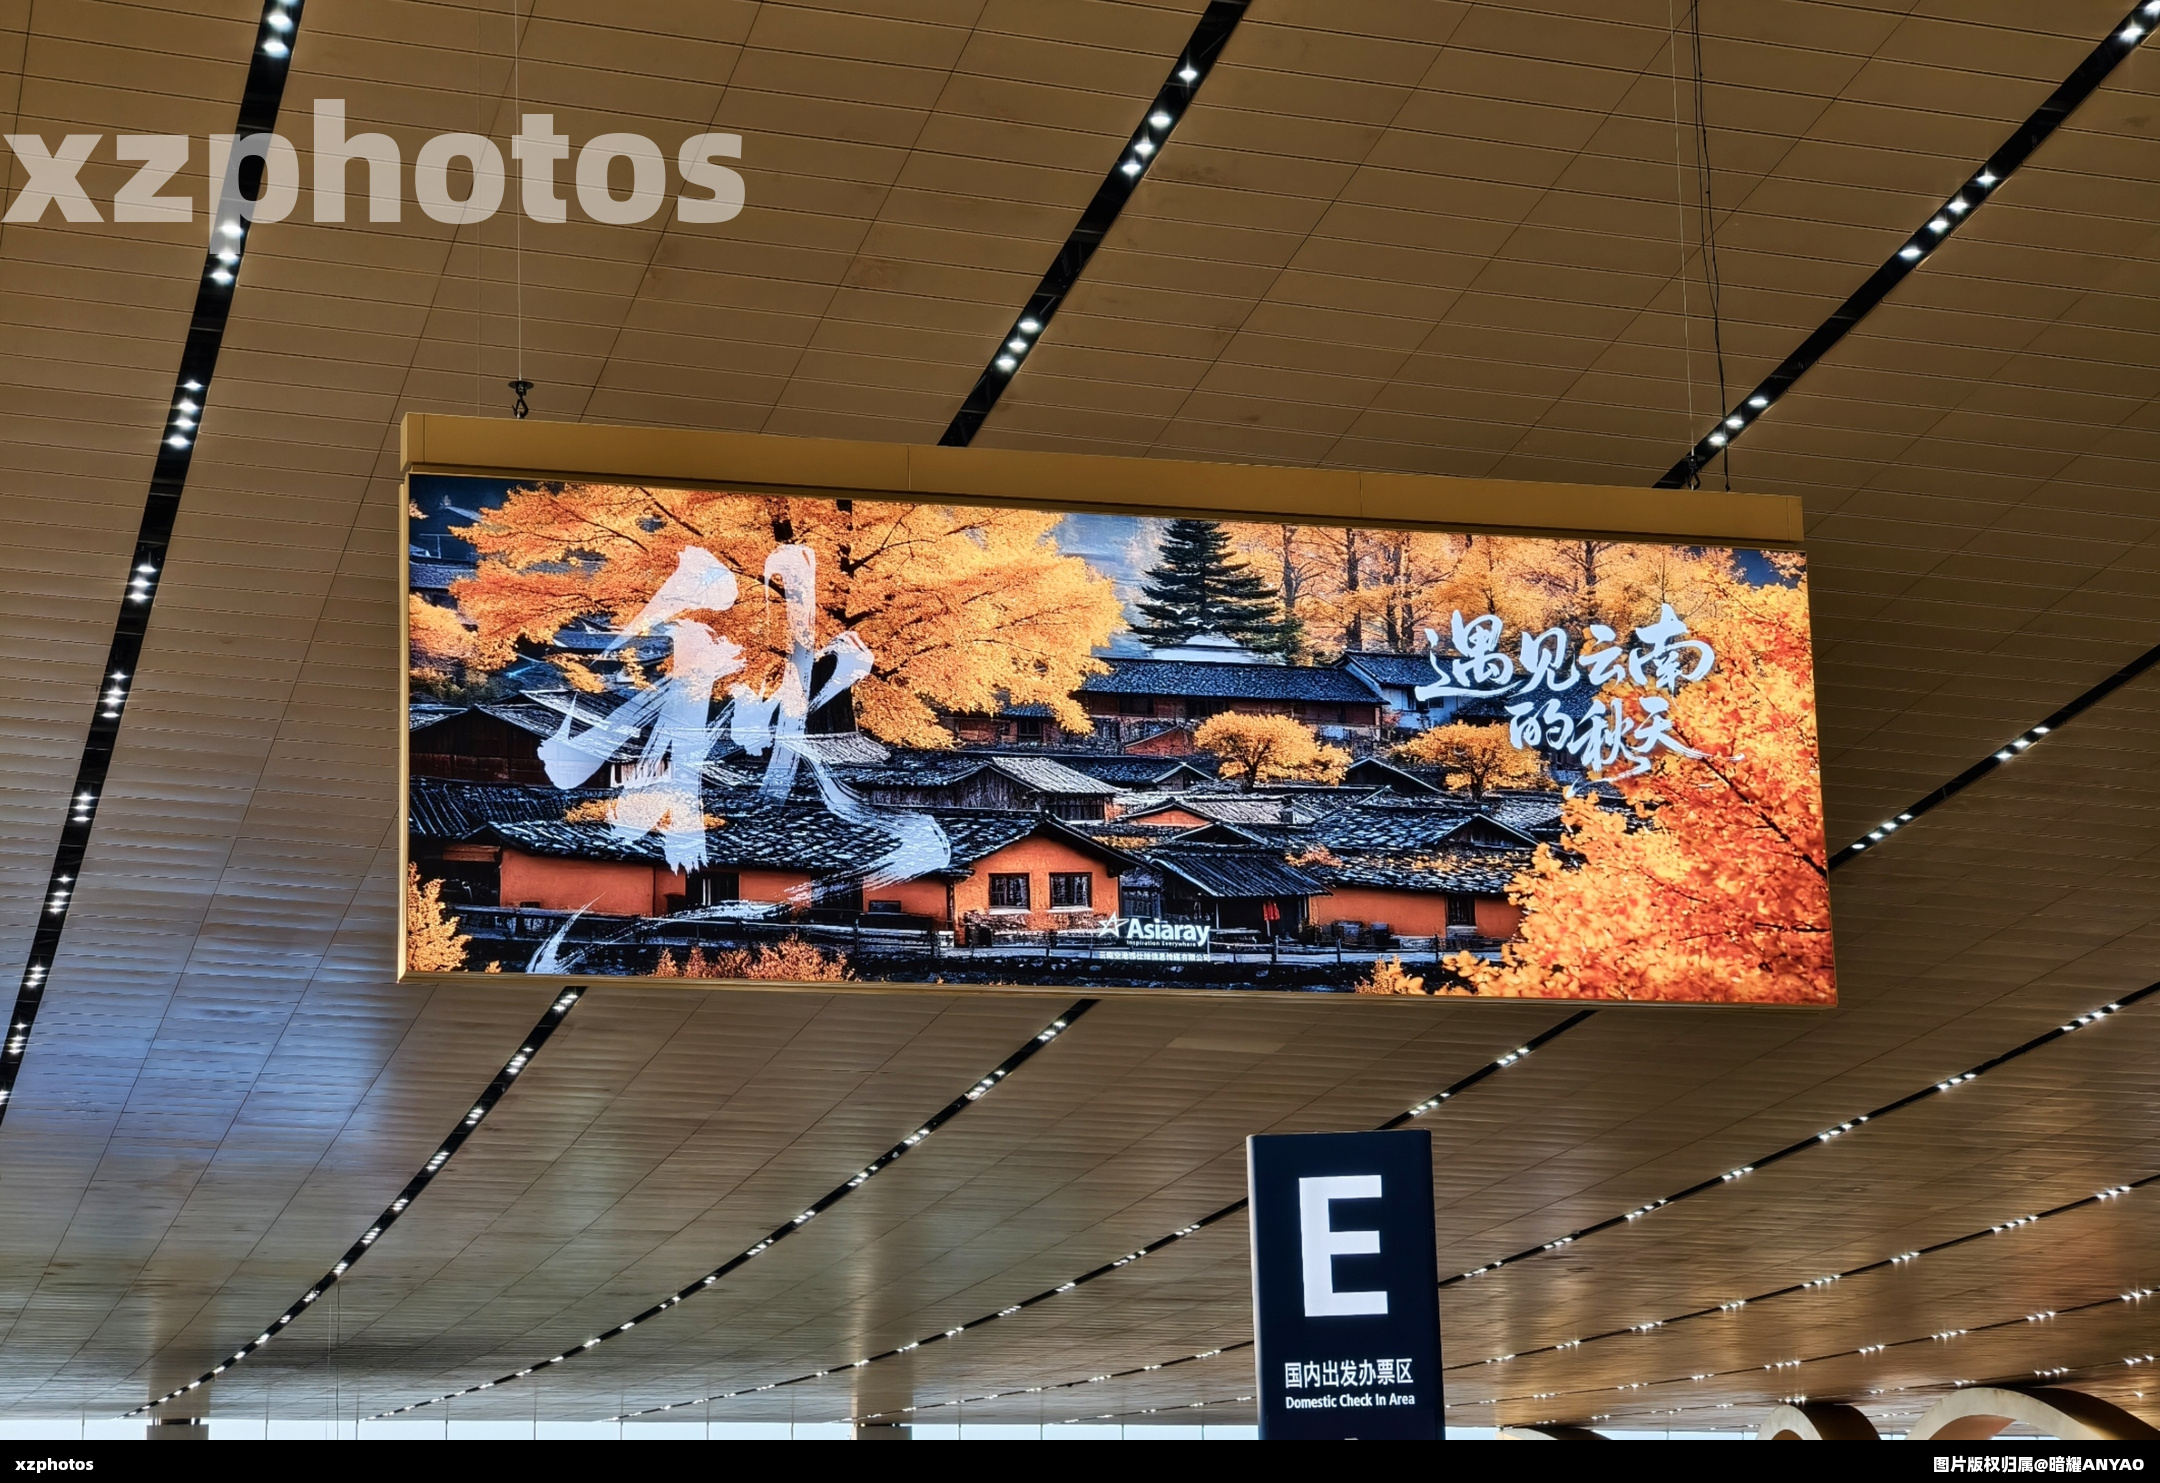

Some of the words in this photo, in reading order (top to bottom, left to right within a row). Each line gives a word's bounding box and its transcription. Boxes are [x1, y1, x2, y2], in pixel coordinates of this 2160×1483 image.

[1414, 603, 1715, 706] 遇见云南
[526, 544, 951, 974] 秋
[1503, 696, 1745, 799] 的秋天
[1126, 917, 1211, 947] Asiaray
[1298, 1174, 1389, 1317] E
[1284, 1358, 1414, 1389] 国内出发办票区
[1285, 1394, 1338, 1409] Domestic
[1339, 1393, 1373, 1407] Check
[1375, 1393, 1386, 1406] In
[1388, 1393, 1415, 1406] Area
